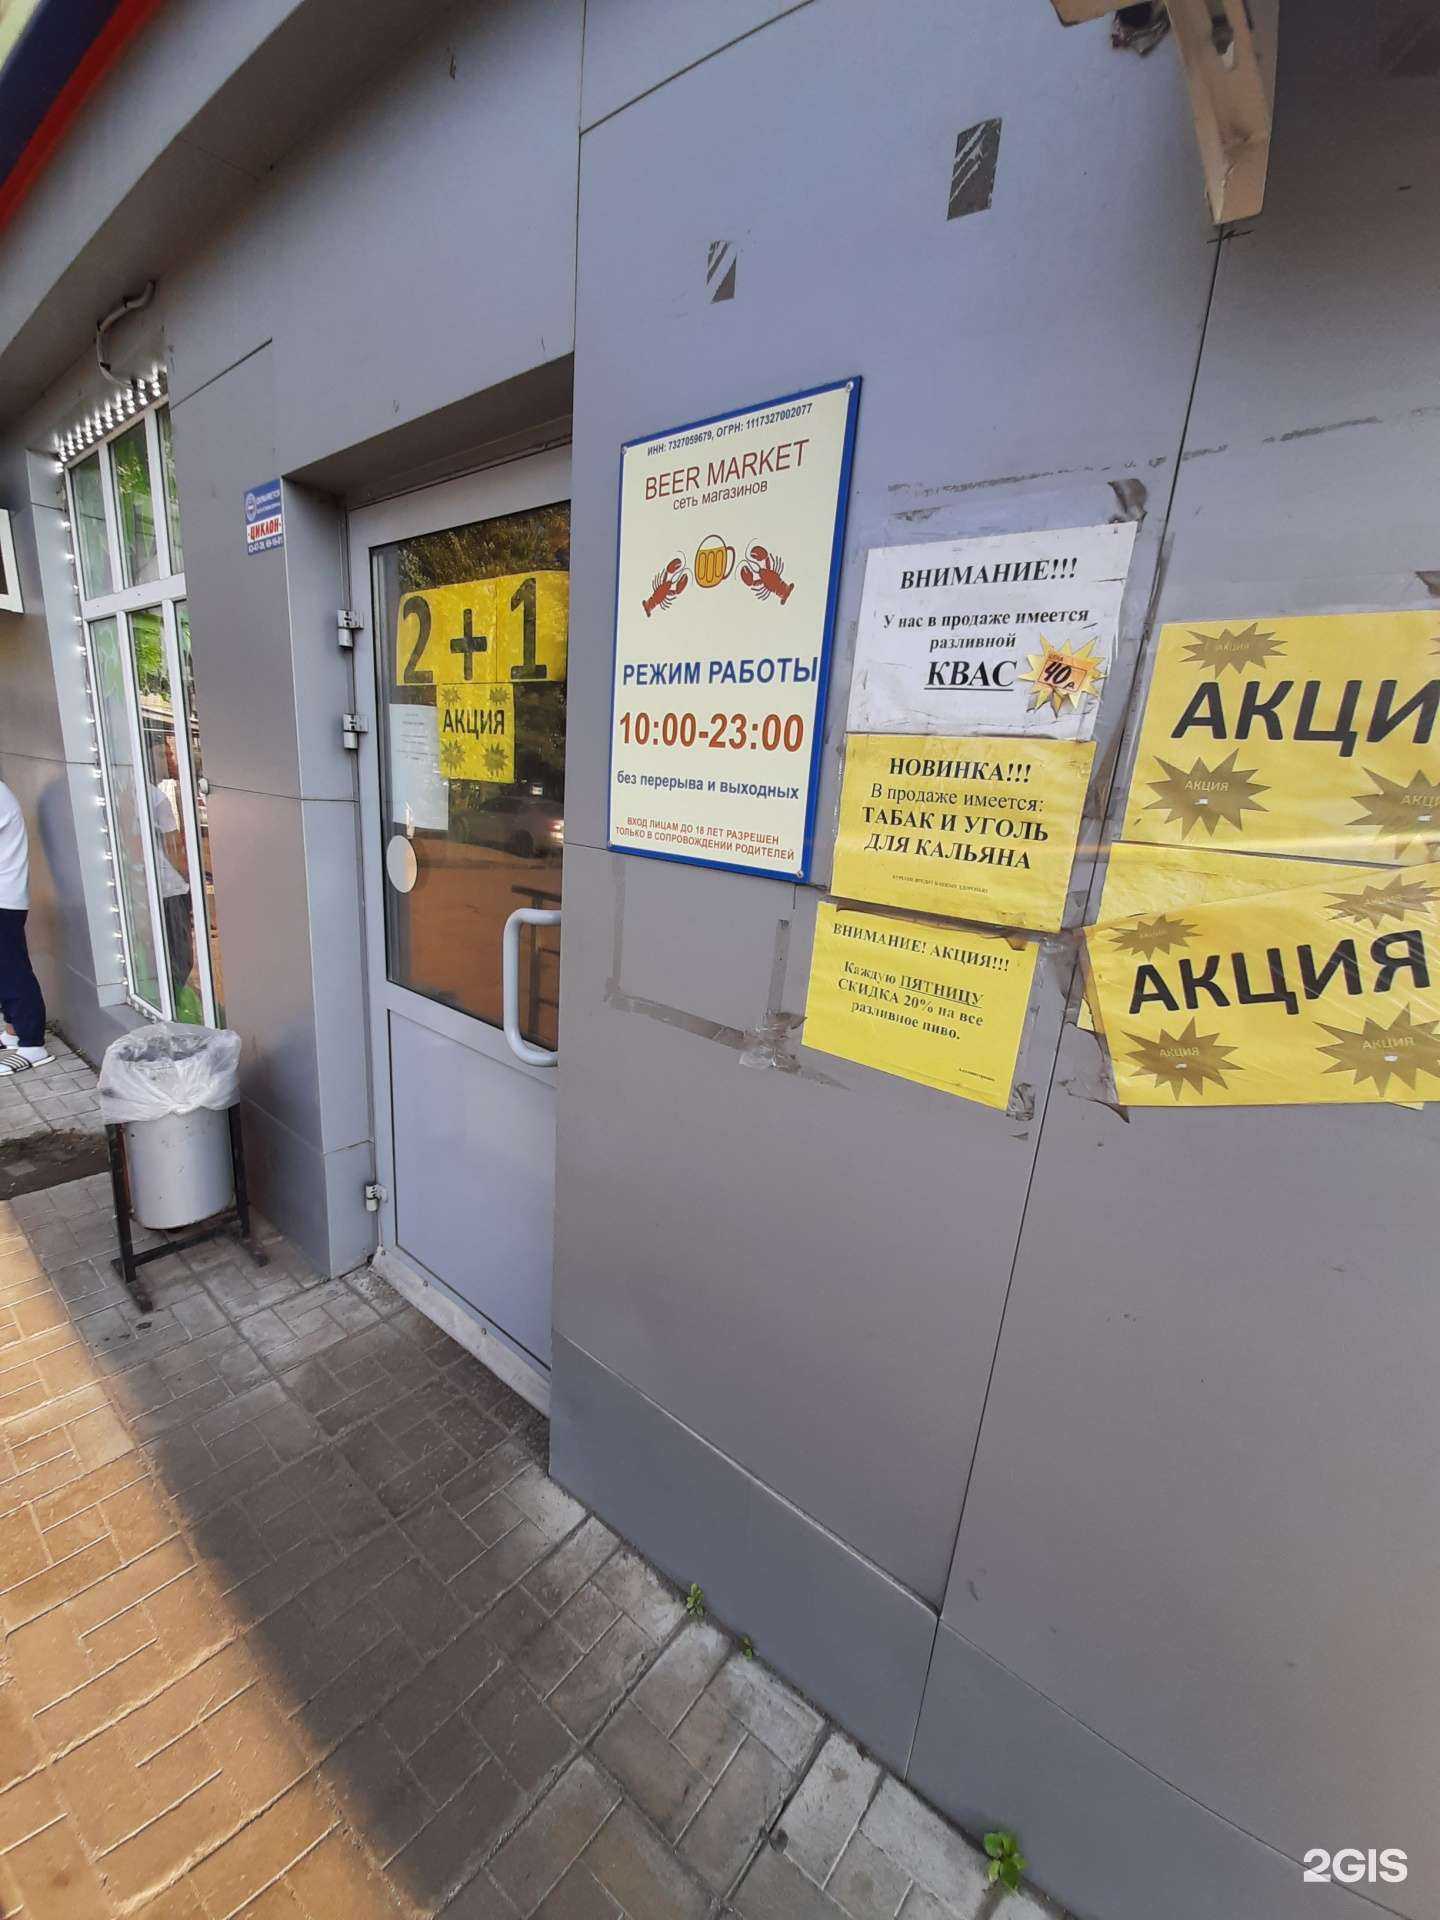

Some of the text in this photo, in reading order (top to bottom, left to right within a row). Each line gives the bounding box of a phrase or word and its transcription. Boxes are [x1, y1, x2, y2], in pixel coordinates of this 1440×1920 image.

[647, 442, 667, 456] ИНН:
[668, 429, 715, 453] 7327059679,
[716, 421, 744, 438] ОГРН:
[645, 438, 811, 500] BEER MARKET
[673, 480, 768, 510] сеть магазинов
[900, 556, 1079, 589] ВНИМАНИЕ!!!
[883, 608, 1090, 631] У нас в продаже имеется
[929, 632, 1016, 653] разливной
[622, 656, 818, 685] РЕЖИМ РАБОТЫ
[925, 659, 1018, 687] КВАС
[1043, 661, 1073, 684] 40
[443, 708, 505, 740] АКЦИЯ
[619, 711, 804, 752] 10:00-23:00
[616, 770, 799, 799] без перерыва и выходных
[889, 757, 1032, 783] НОВИНКА!!!
[1184, 779, 1230, 792] АКЦИЯ
[871, 783, 1045, 812] В продаже имеется:
[627, 816, 648, 828] ВХОД
[649, 819, 680, 832] ЛИЦАМ
[680, 822, 694, 834] ДО
[706, 825, 724, 837] ЛЕТ
[726, 827, 780, 846] РАЗРЕШЕН
[862, 805, 1049, 843] ТАБАК И УГОЛЬ
[616, 826, 795, 861] ТОЛЬКО В СОПРОВОЖДЕНИИ РОДИТЕЛЕЙ
[863, 832, 1032, 870] ДЛЯ КАЛЬЯНА
[833, 922, 1011, 973] ВНИМАНИЕ! АКЦИЯ!!!
[844, 961, 984, 1006] Каждую ПЯТНИЦУ
[1128, 928, 1431, 1017] АКЦИЯ
[837, 977, 984, 1027] СКИДКА 20% на все
[850, 1001, 961, 1041] разливное пиво.
[1158, 1046, 1201, 1058] АКЦИЯ
[1361, 1035, 1417, 1050] АКЦИЯ
